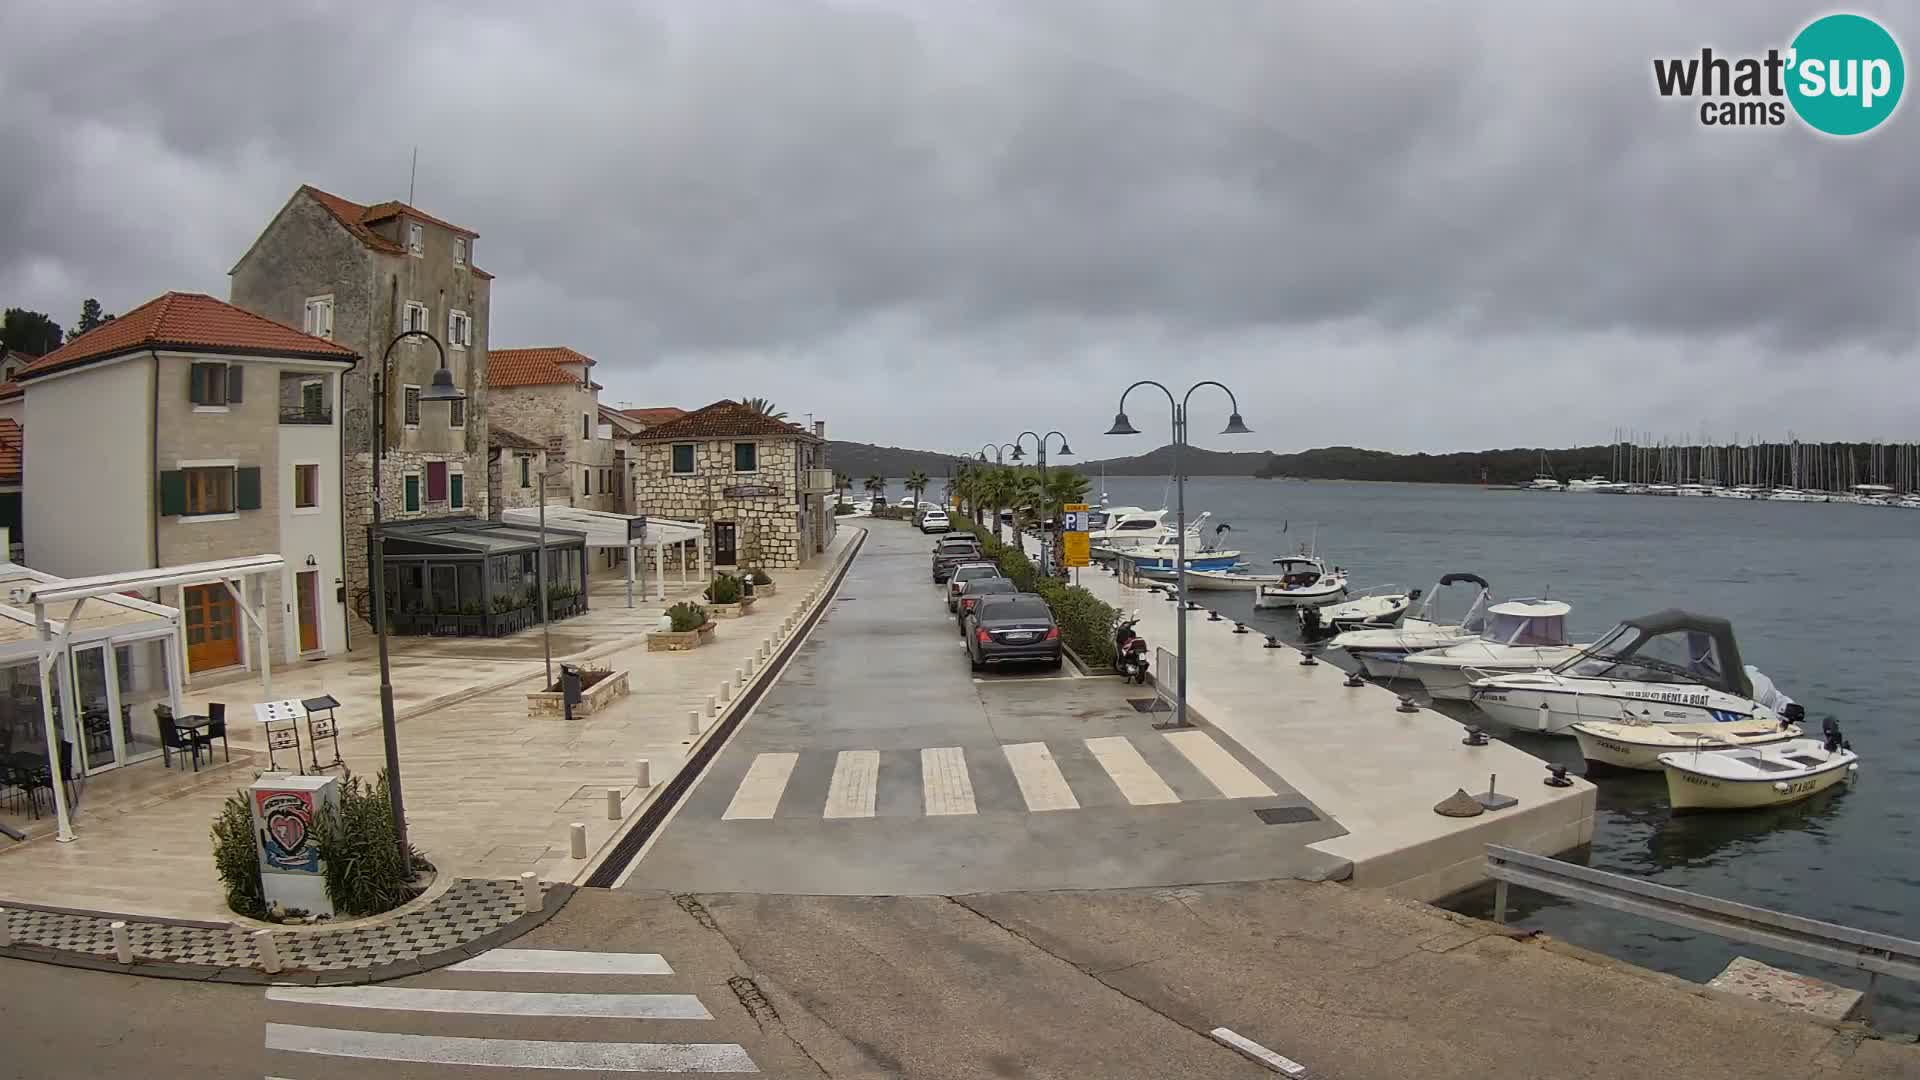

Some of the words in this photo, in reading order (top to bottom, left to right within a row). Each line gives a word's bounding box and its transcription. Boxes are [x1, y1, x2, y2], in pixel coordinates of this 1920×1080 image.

[1066, 514, 1076, 529] P
[1661, 692, 1681, 703] RENT
[1682, 693, 1689, 703] A
[1690, 694, 1710, 706] BOAT
